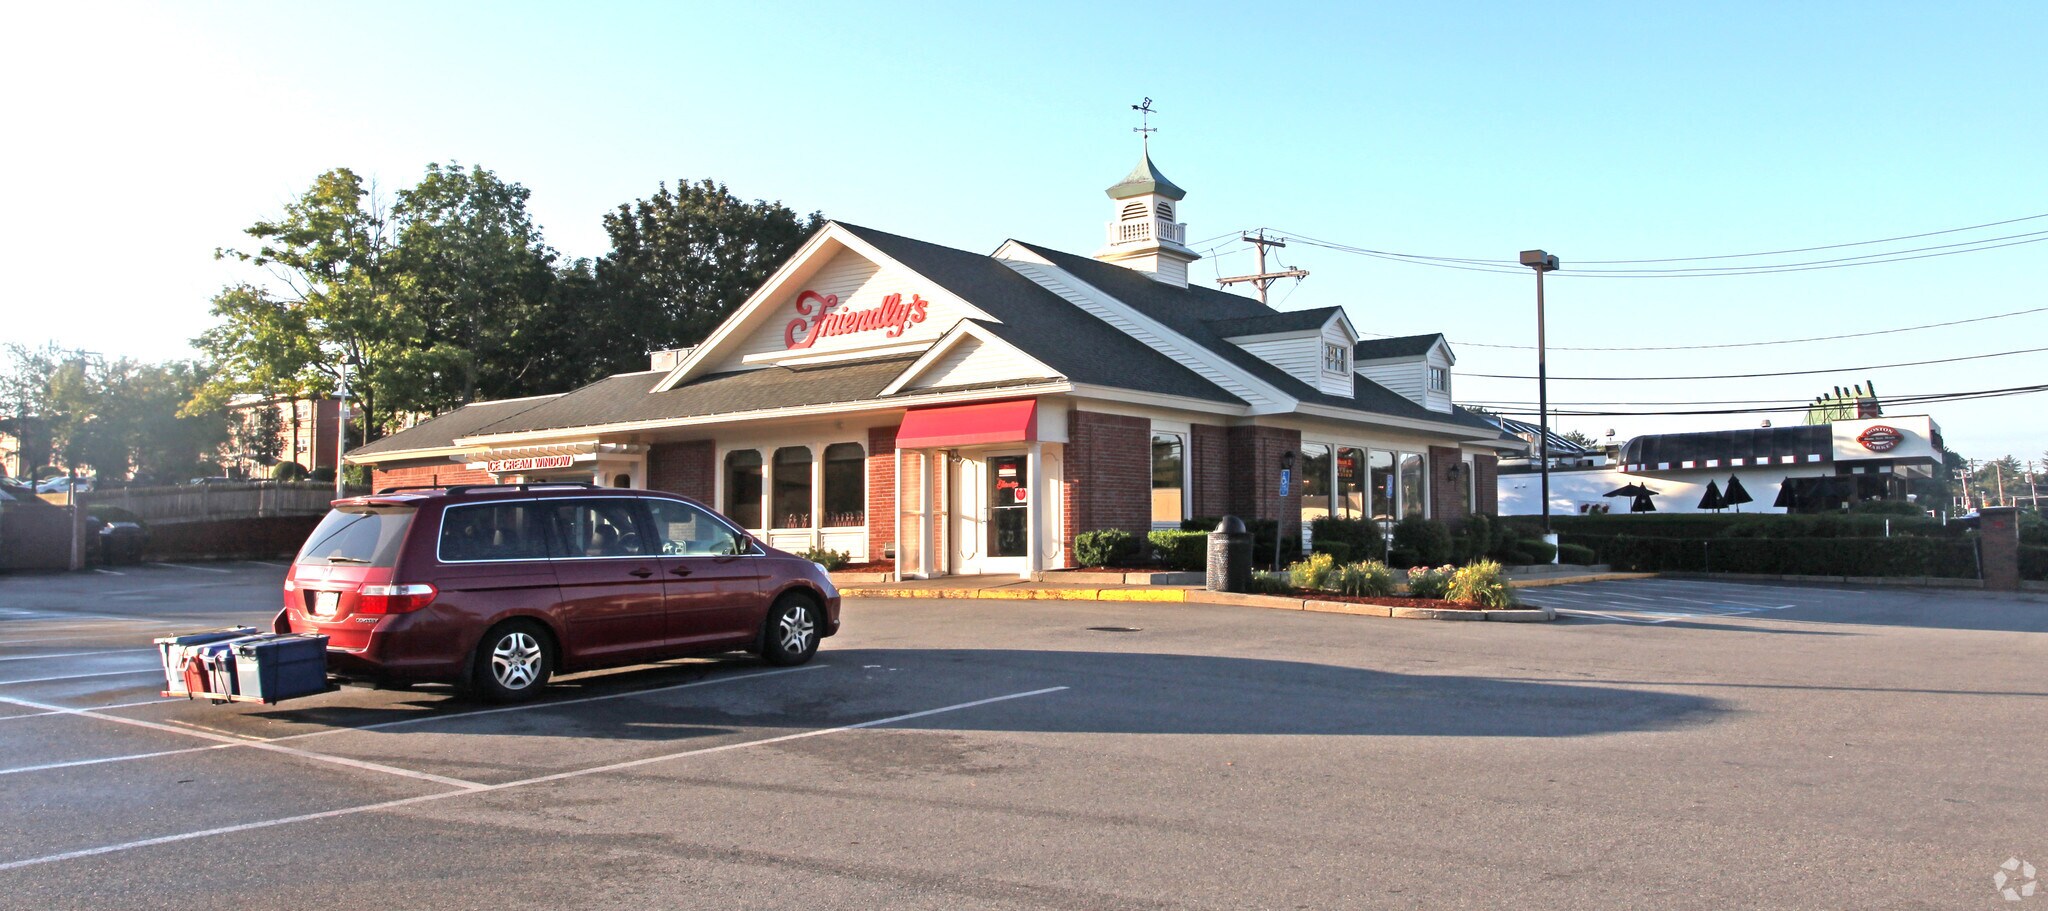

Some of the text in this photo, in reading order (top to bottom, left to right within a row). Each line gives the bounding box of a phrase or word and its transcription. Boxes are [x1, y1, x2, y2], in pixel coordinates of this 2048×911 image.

[784, 290, 928, 350] Friendly's
[1866, 427, 1893, 435] BOSTON
[1866, 442, 1894, 450] MARKET
[487, 456, 571, 471] ICE CREAM WINDOW
